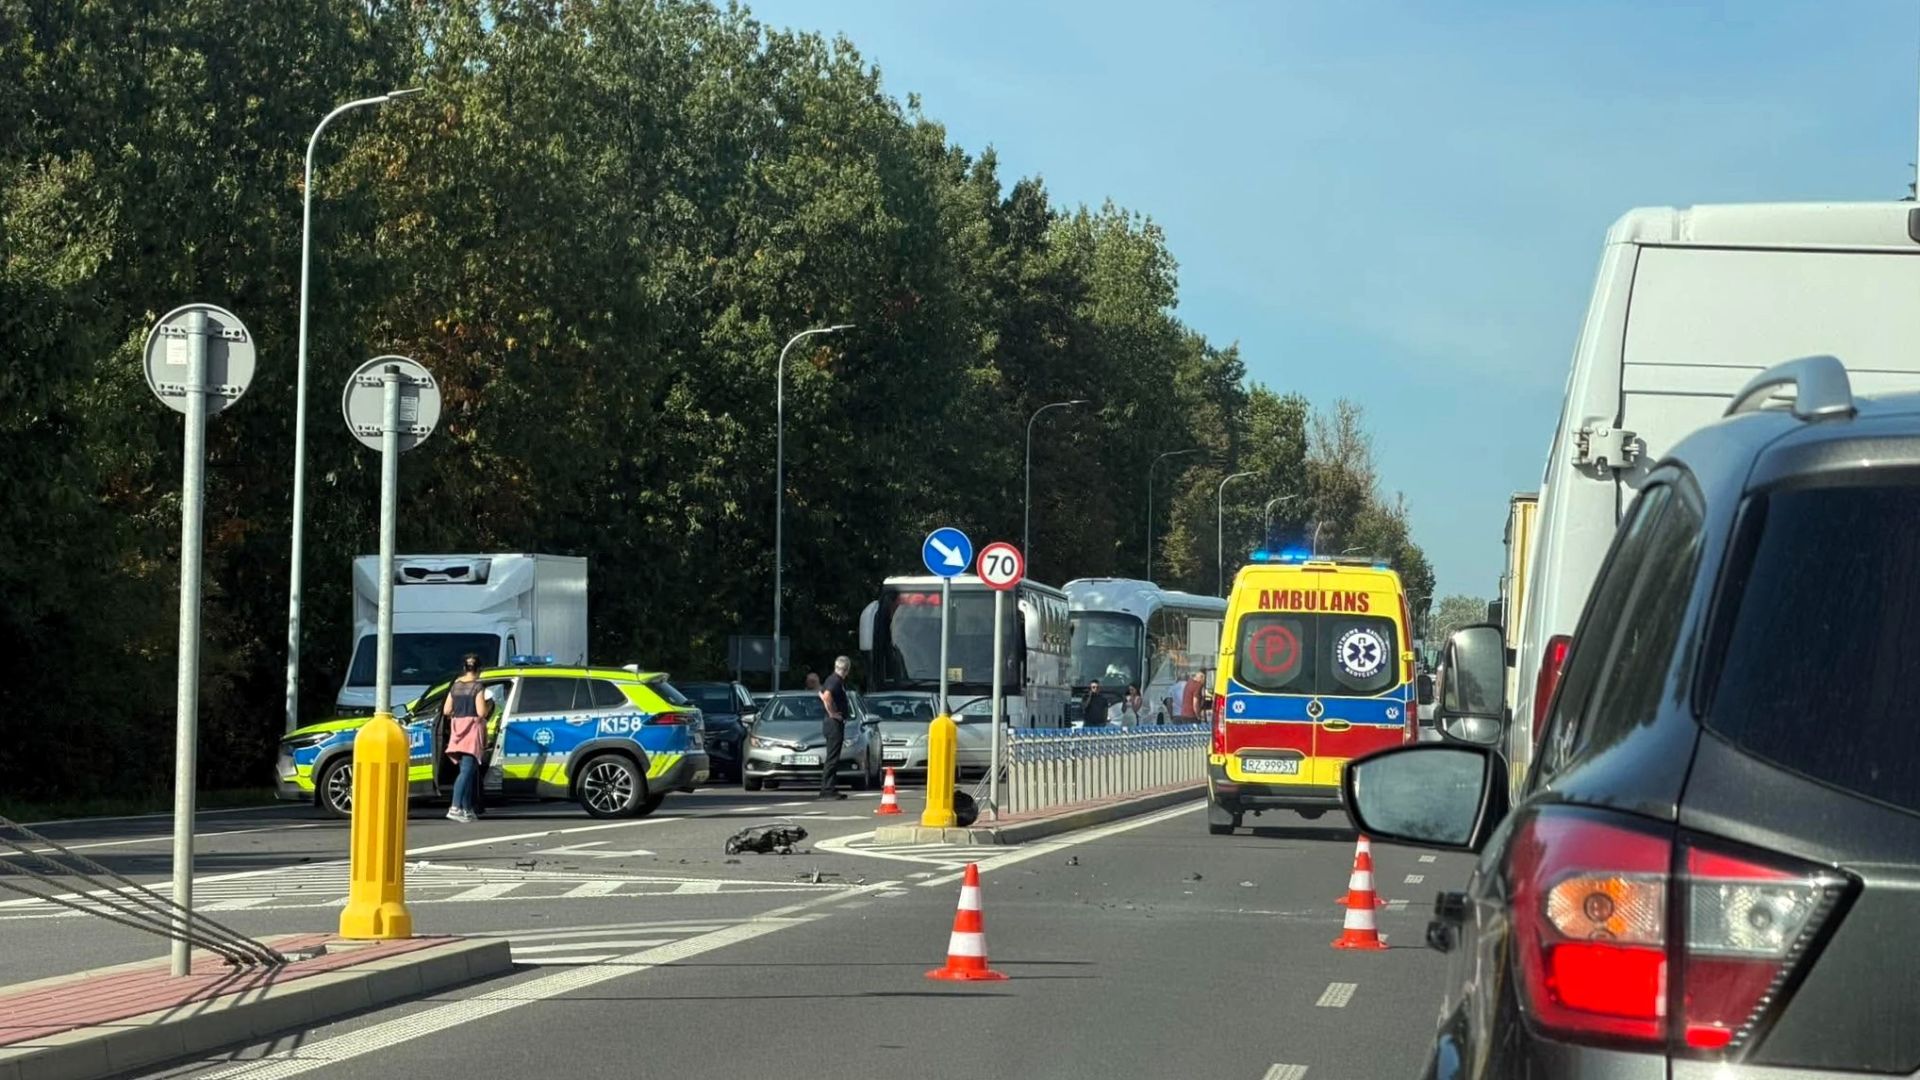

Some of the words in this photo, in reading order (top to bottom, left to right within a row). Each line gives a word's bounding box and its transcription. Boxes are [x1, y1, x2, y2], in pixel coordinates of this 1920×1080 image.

[987, 555, 1015, 577] 70
[1258, 589, 1369, 613] AMBULANS
[1265, 636, 1284, 664] P
[600, 717, 642, 733] K158
